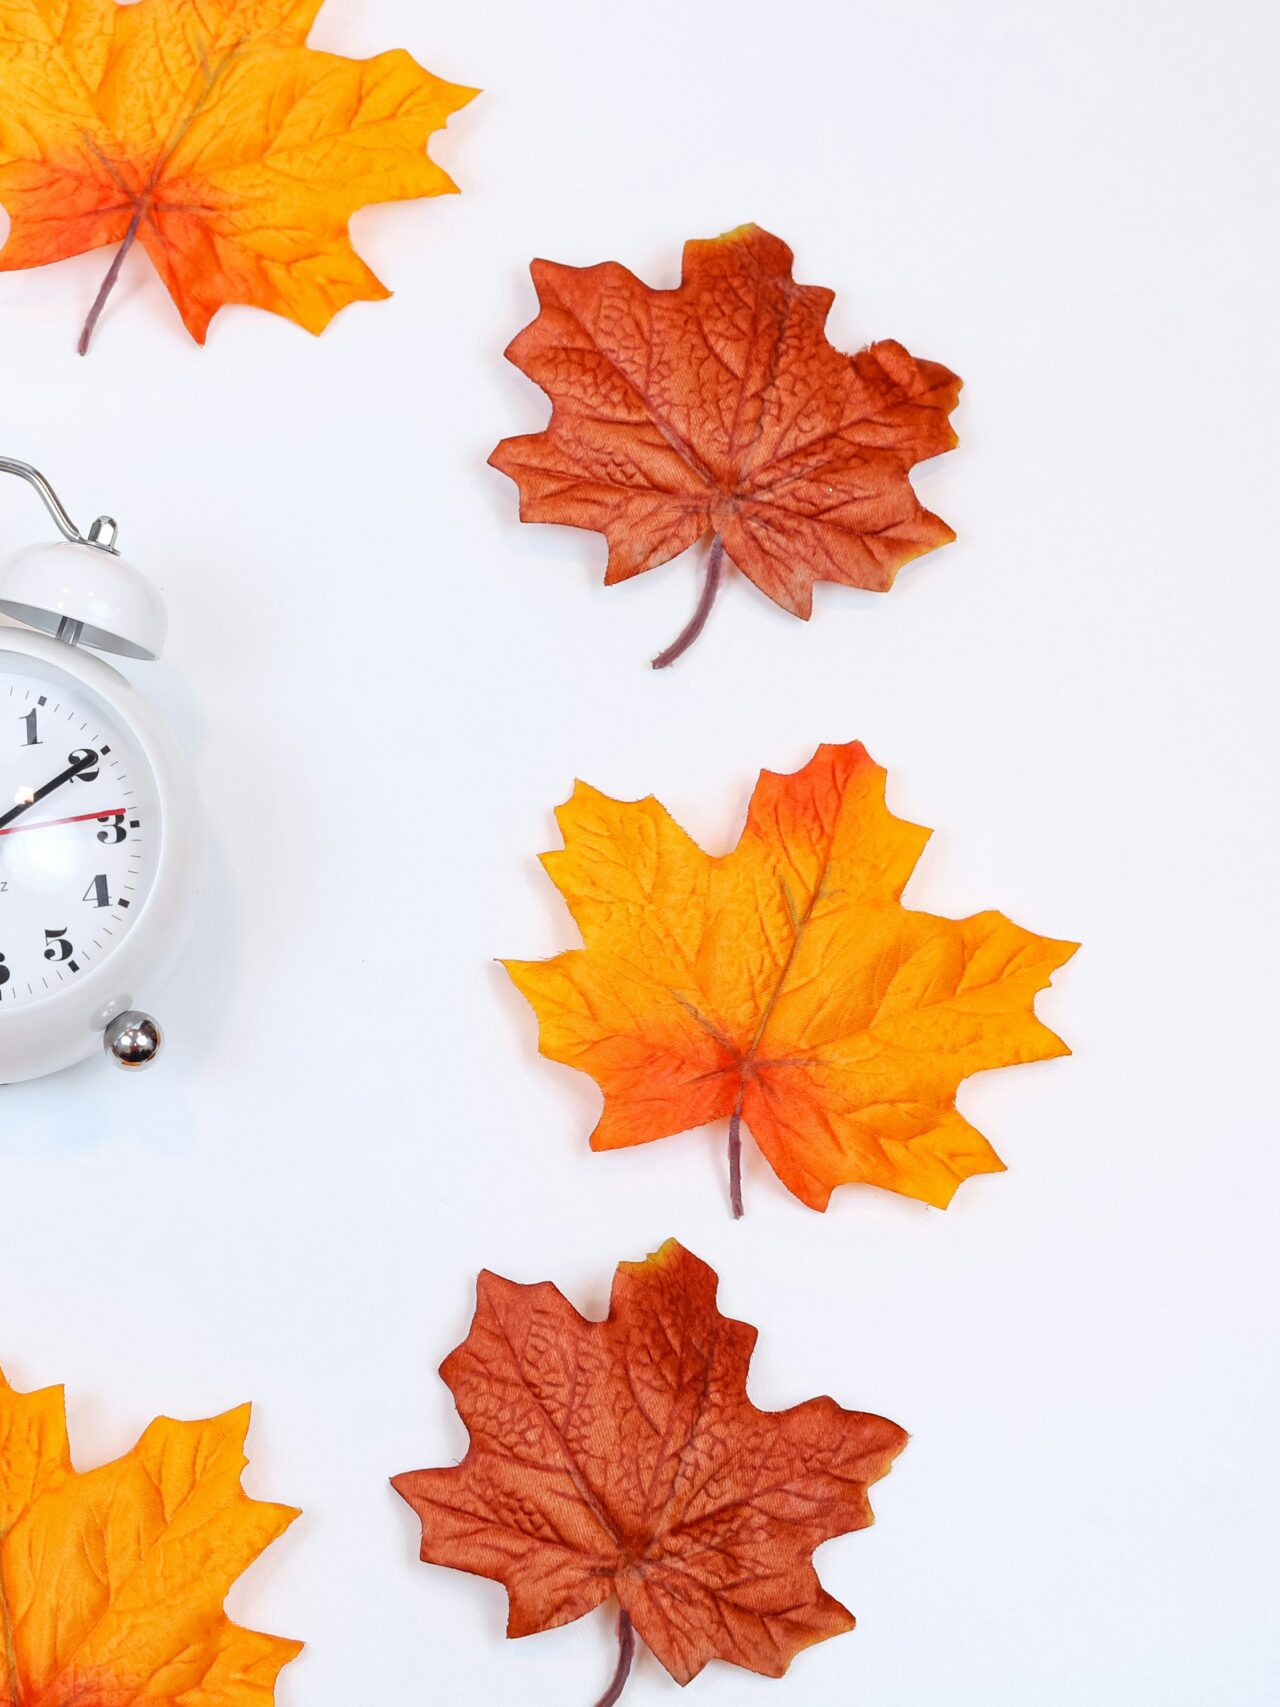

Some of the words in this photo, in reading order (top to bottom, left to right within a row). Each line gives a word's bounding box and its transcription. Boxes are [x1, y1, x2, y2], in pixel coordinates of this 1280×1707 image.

[18, 708, 44, 747] 1
[68, 748, 100, 784] 2
[96, 811, 127, 845] 3
[82, 874, 113, 909] 4
[43, 926, 74, 962] 5
